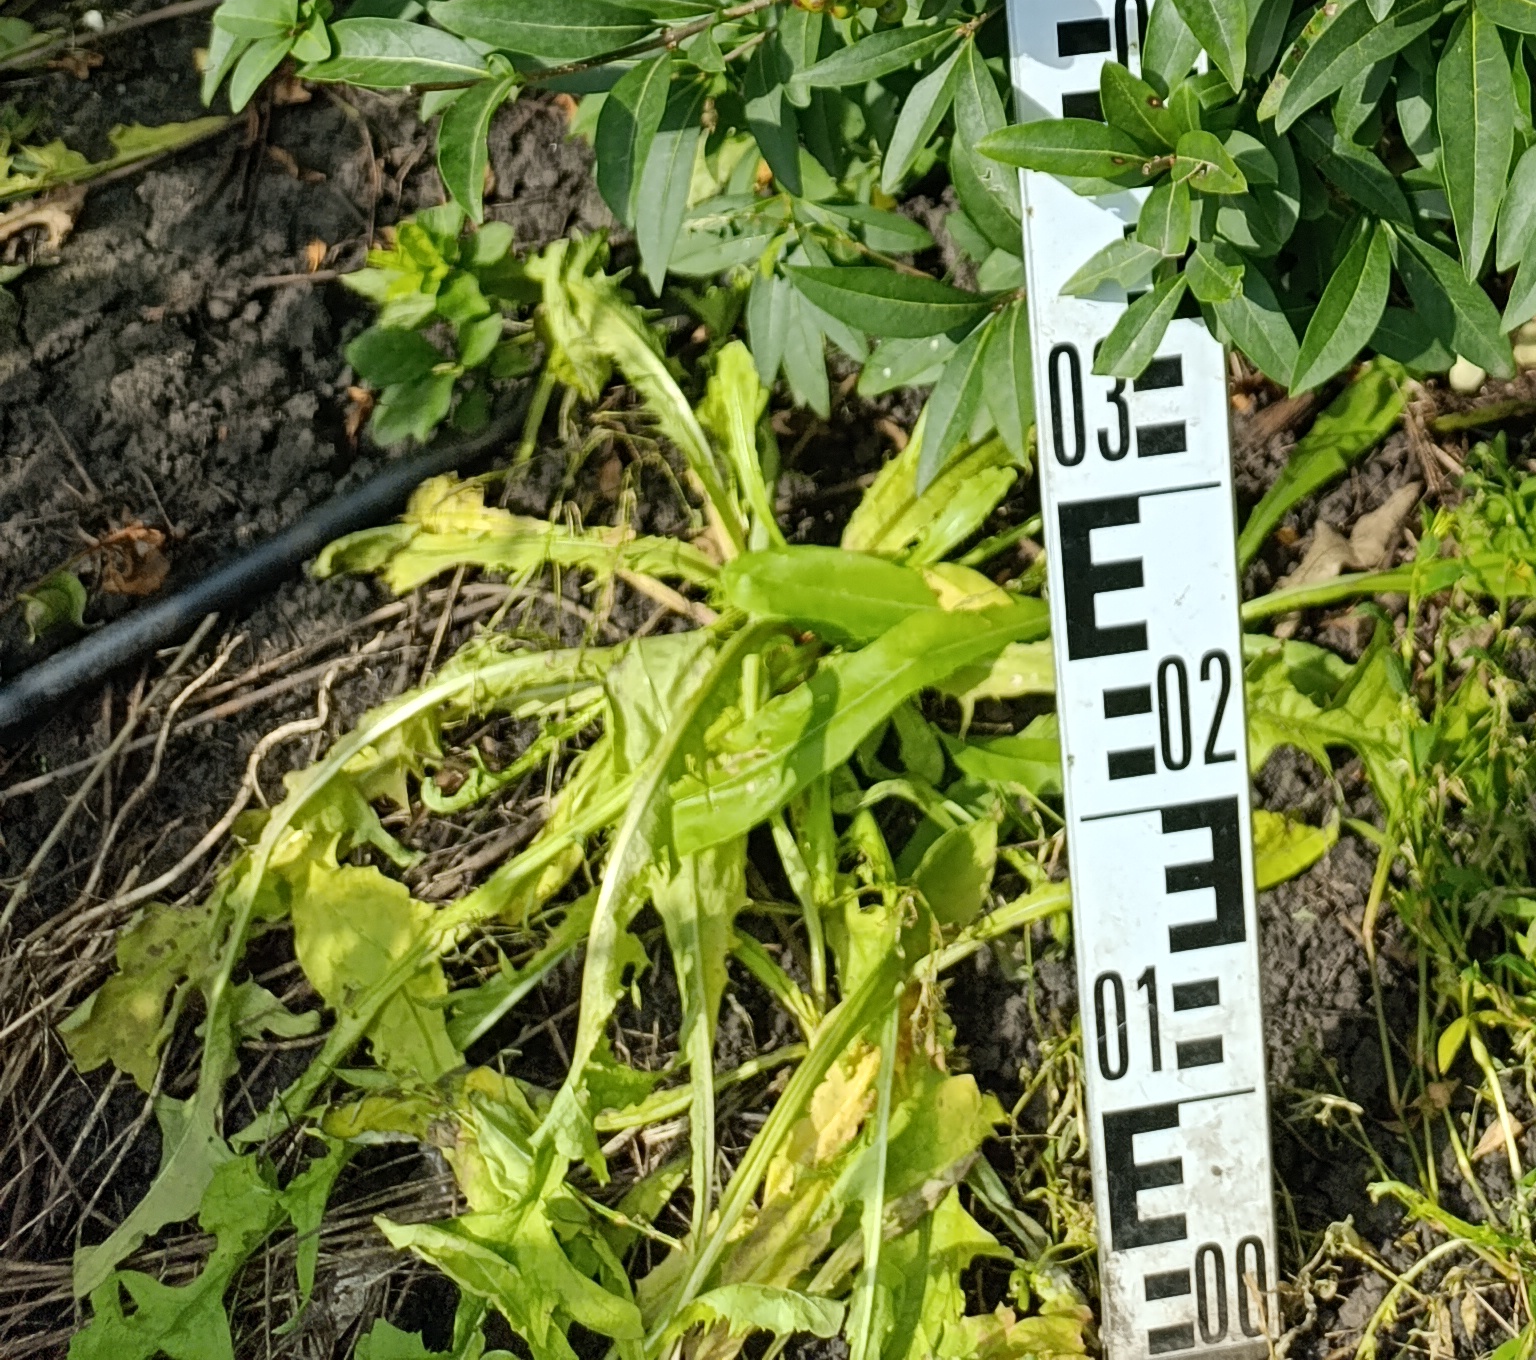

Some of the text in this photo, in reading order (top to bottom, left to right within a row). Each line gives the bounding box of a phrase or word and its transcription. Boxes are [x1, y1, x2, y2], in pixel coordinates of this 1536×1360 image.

[1048, 337, 1131, 467] 03
[1157, 648, 1238, 771] 02
[1093, 964, 1162, 1080] 01
[1194, 1234, 1269, 1345] 00
